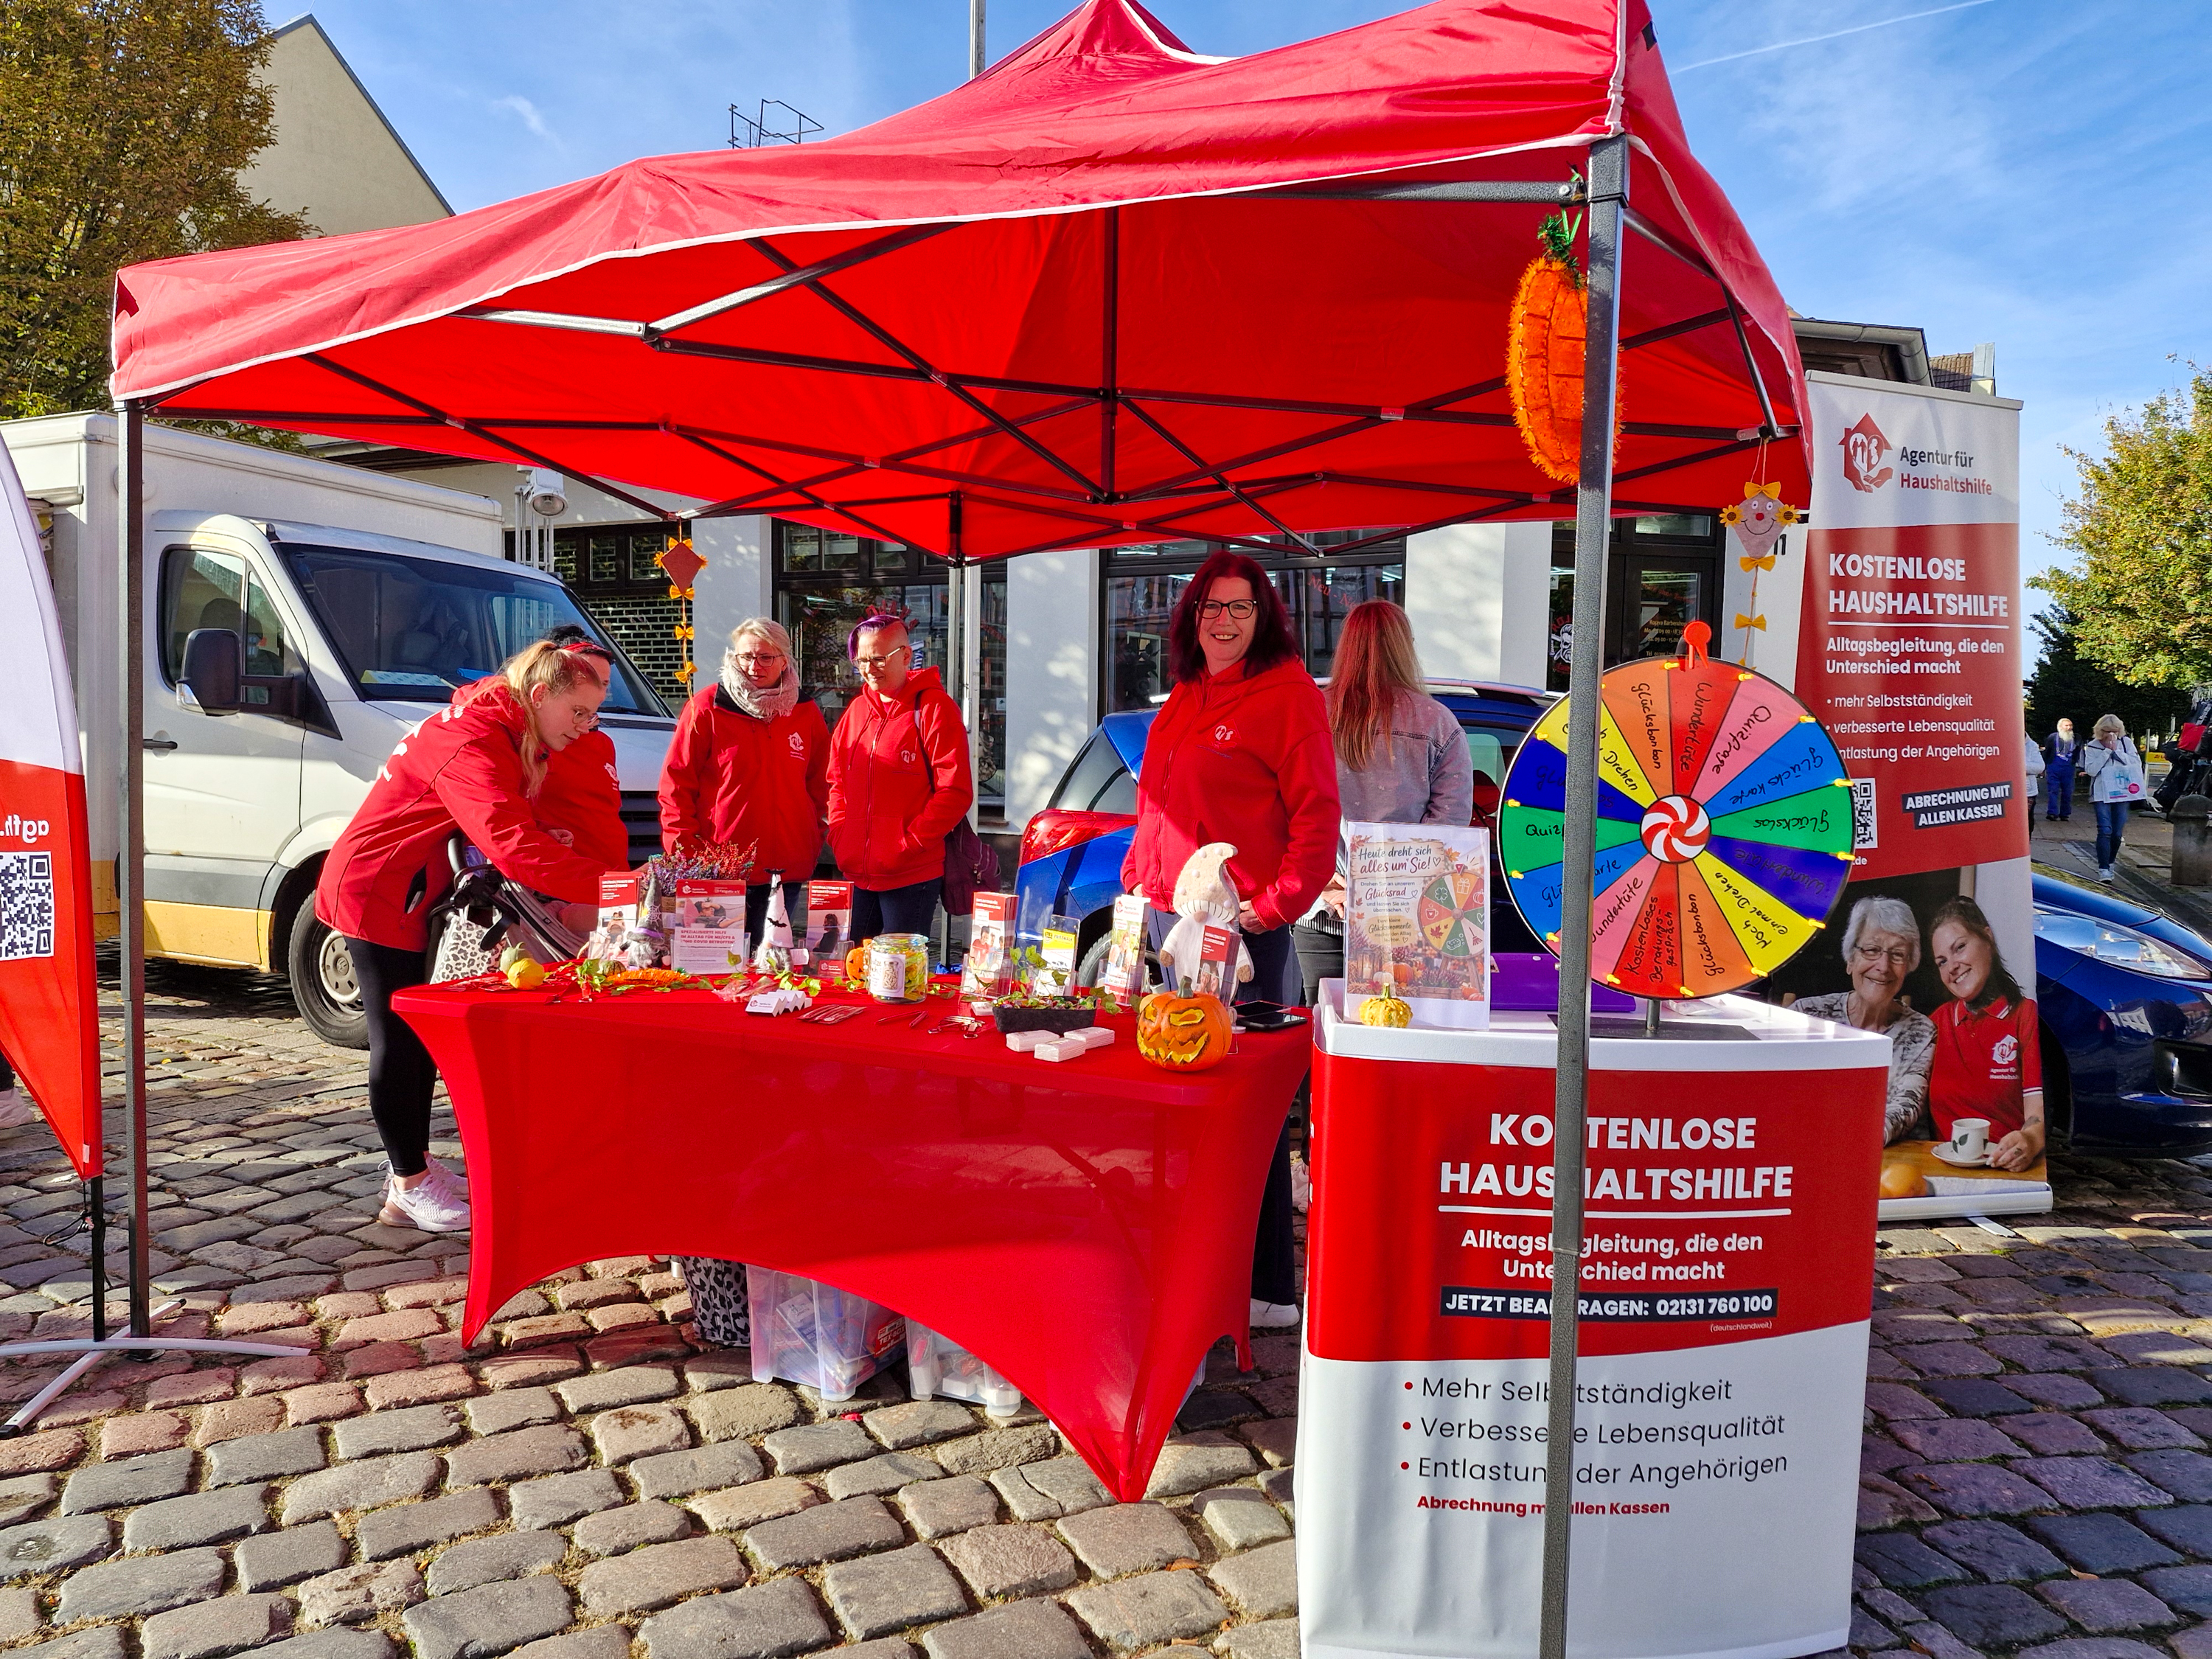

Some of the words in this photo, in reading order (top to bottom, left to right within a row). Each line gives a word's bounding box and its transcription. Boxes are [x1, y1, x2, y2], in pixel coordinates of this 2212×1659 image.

[1900, 446, 1952, 466] Agentur
[1955, 451, 1974, 468] für
[1900, 473, 1992, 495] Haushaltshilfe
[1829, 553, 1966, 581] KOSTENLOSE
[1829, 590, 2008, 617] HAUSHALTSHILFE
[1826, 637, 1955, 656] Alltagsbegleitung,
[1958, 639, 1980, 653] die
[1981, 639, 2004, 653] den
[1826, 660, 1911, 674] Unterschied
[1914, 661, 1961, 674] macht
[1834, 695, 1865, 708] mehr
[1867, 693, 1973, 710] Selbstständigkeit
[1834, 720, 1905, 734] verbesserte
[1908, 718, 1995, 735] Lebensqualität
[1839, 745, 1898, 762] ntlastung
[1901, 745, 1923, 759] der
[1926, 745, 2000, 761] Angehörigen
[1905, 787, 1989, 810] ABRECHNUNG
[1991, 784, 2010, 799] MIT
[1919, 810, 1955, 827] ALLEN
[1957, 804, 2003, 821] KASSEN
[1358, 847, 1385, 860] Heute
[1388, 846, 1412, 857] dreht
[1416, 844, 1432, 855] sich
[1360, 859, 1388, 874] alles
[1391, 862, 1407, 871] um
[1410, 856, 1430, 873] Sie!
[1366, 887, 1407, 900] Glücksrad
[1489, 1113, 1756, 1150] KOTENLOSE
[1461, 1229, 1680, 1259] Alltagsgleitung,
[1686, 1234, 1719, 1253] die
[1723, 1233, 1763, 1251] den
[1503, 1259, 1646, 1281] Untechied
[1651, 1261, 1725, 1280] macht
[1446, 1294, 1506, 1313] JETZT
[1510, 1297, 1649, 1316] BEARAGEN:
[1656, 1298, 1705, 1315] 02131
[1707, 1297, 1740, 1315] 760
[1742, 1295, 1773, 1312] 100
[1710, 1320, 1773, 1333] (deutschlandweit)
[1422, 1377, 1492, 1400] Mehr
[1501, 1379, 1733, 1409] Seltständigkeit
[1421, 1416, 1588, 1443] Verbessee
[1598, 1414, 1785, 1447] Lebensqualität
[1418, 1457, 1548, 1483] Entlastun
[1576, 1463, 1621, 1484] der
[1630, 1453, 1787, 1489] Angehörigen
[1417, 1496, 1526, 1517] Abrechnung
[1610, 1500, 1670, 1515] Kassen
